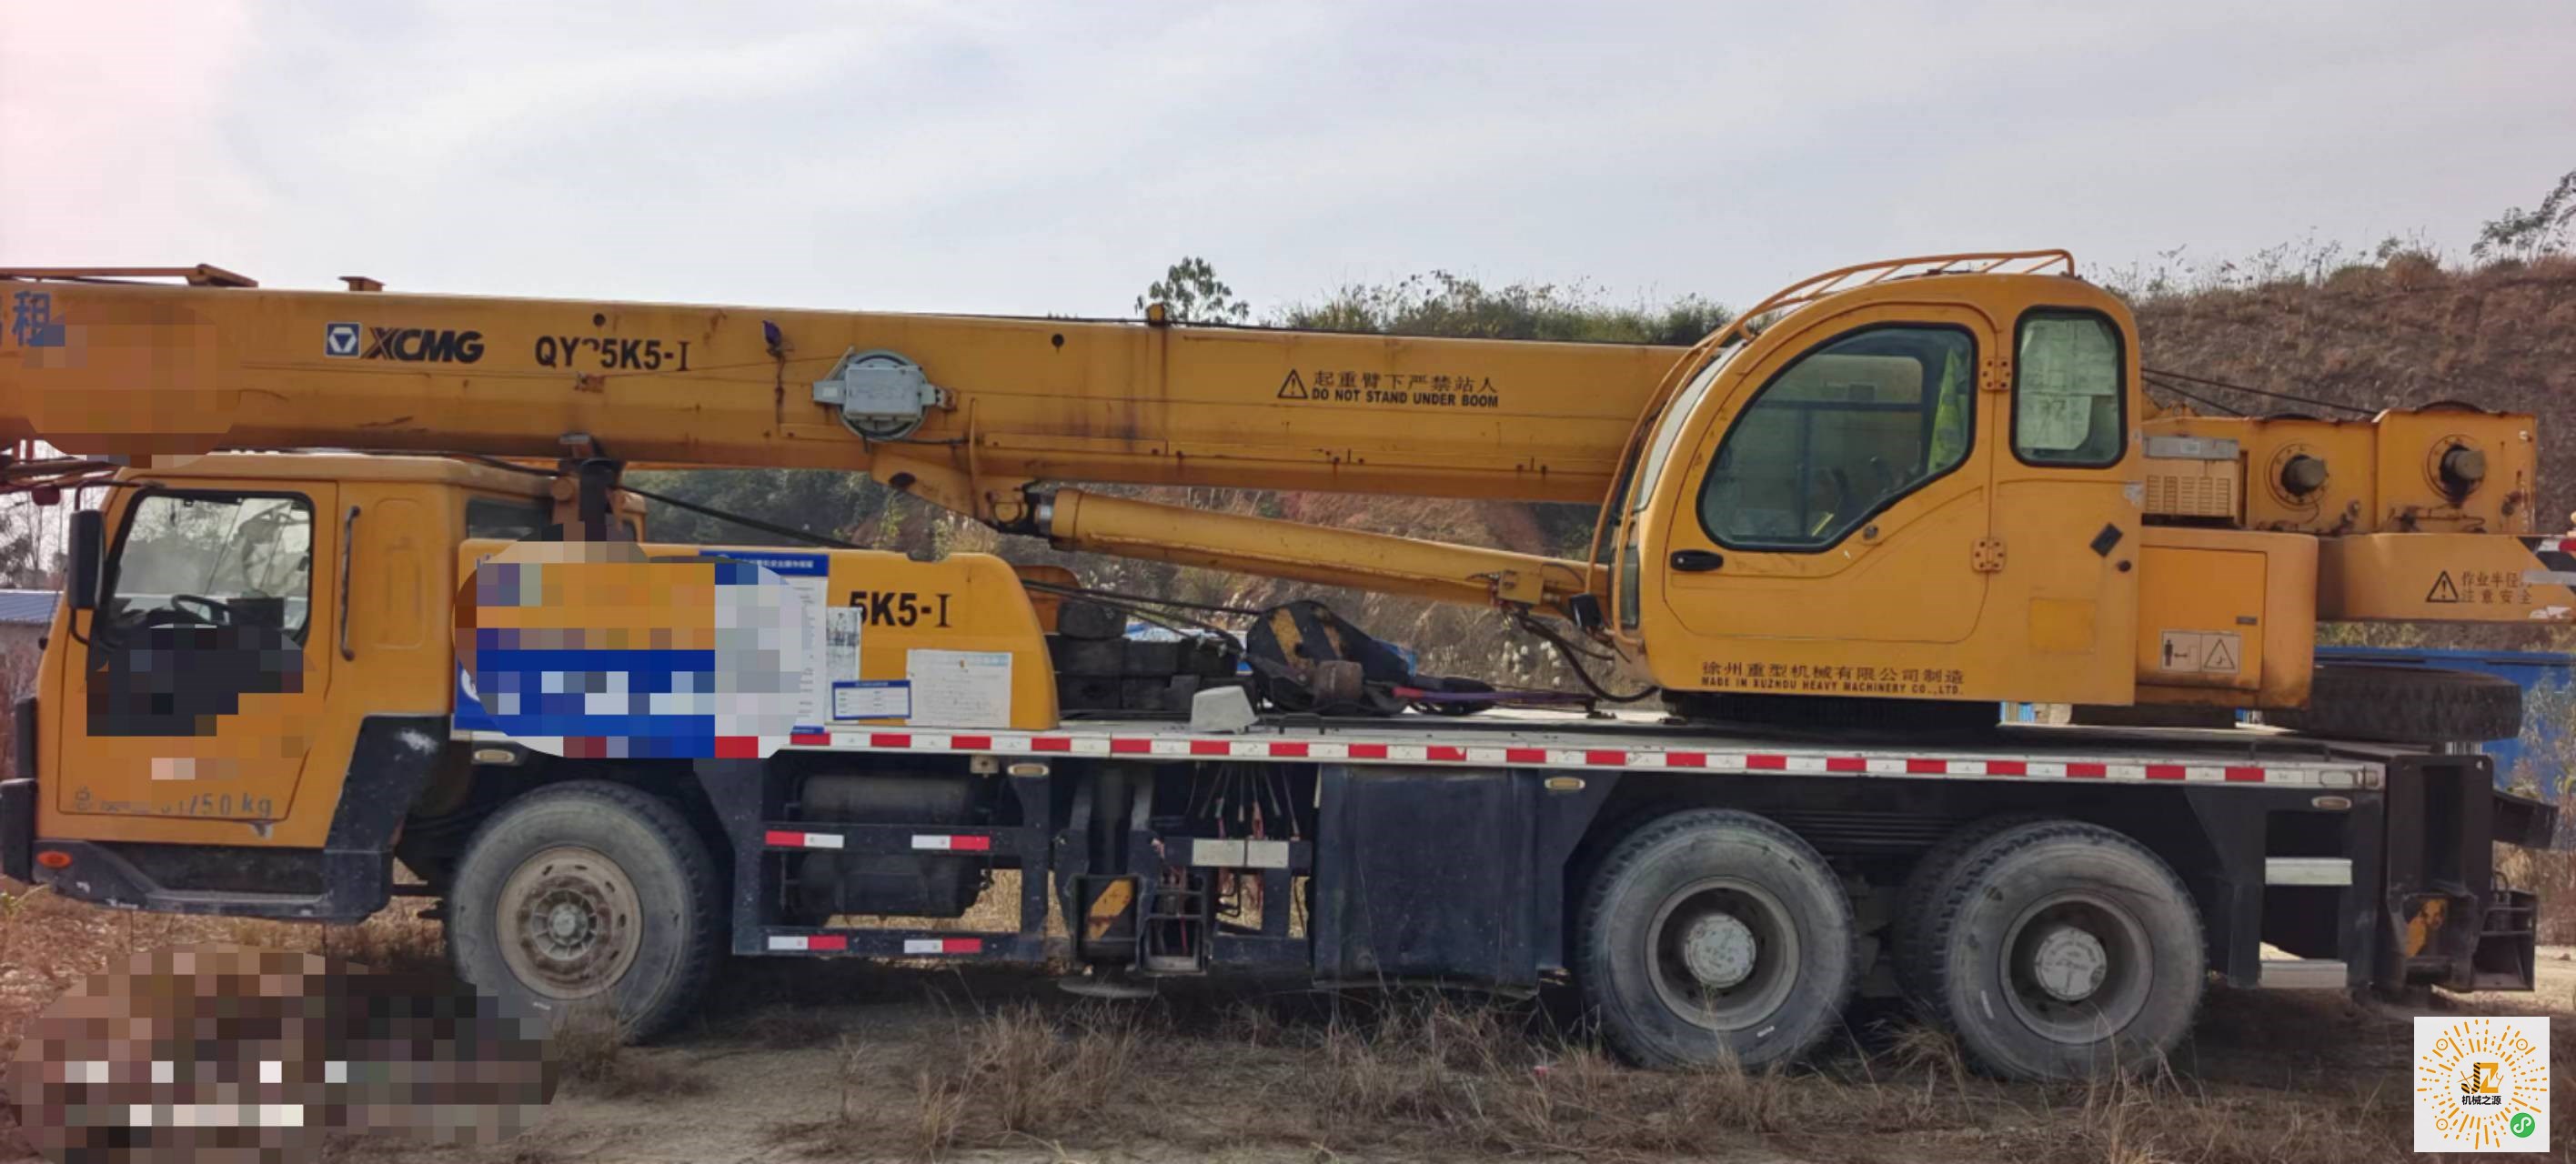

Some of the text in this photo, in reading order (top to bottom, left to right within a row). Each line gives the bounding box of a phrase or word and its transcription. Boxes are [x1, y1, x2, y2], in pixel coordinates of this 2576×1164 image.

[362, 326, 485, 364] XCMG
[1313, 370, 1499, 393] 起重臂下严禁站人
[1312, 387, 1499, 407] DO NOT STAND UNDER BOOM
[2460, 589, 2532, 604] 注意安全
[1702, 661, 1964, 685] 徐州重型机械有限公司制造
[1701, 677, 1729, 687] MADE
[1736, 677, 1747, 687] IN
[1802, 680, 1837, 691] HEAVY
[1844, 682, 1907, 693] MACHINERY
[241, 792, 272, 817] kg
